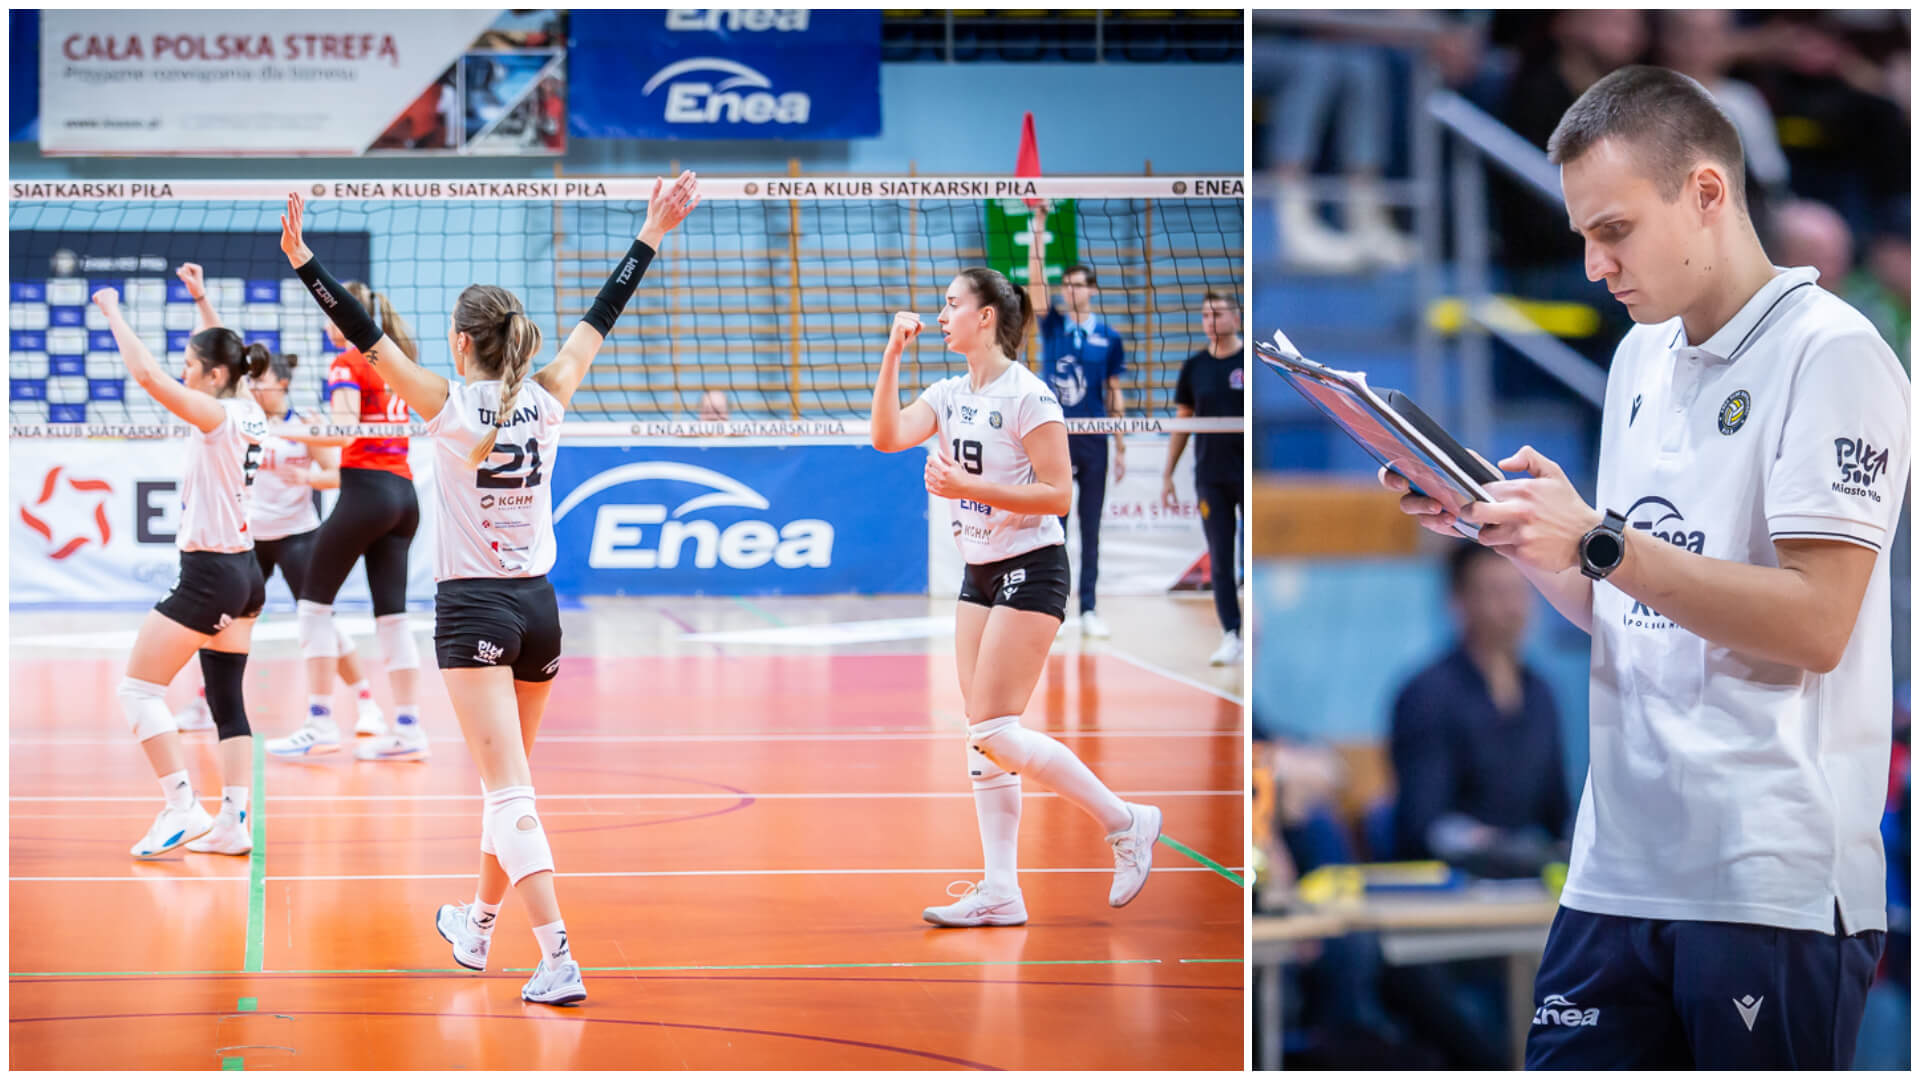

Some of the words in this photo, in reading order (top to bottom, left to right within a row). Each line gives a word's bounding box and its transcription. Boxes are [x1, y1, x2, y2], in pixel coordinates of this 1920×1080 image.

[665, 9, 811, 31] Enea
[62, 34, 145, 61] CAŁA
[153, 34, 275, 61] POLSKA
[284, 34, 399, 67] STREFĄ
[664, 83, 811, 124] Enea
[13, 183, 125, 198] SIATKARSKI
[131, 183, 174, 198] PIŁA
[334, 183, 385, 198] ENEA
[391, 183, 441, 198] KLUB
[447, 183, 559, 198] SIATKARSKI
[565, 183, 607, 198] PIŁA
[766, 182, 817, 197] ENEA
[824, 182, 873, 197] KLUB
[879, 182, 989, 197] SIATKARSKI
[995, 181, 1038, 196] PIŁA
[1194, 180, 1244, 196] ENEA
[616, 257, 639, 286] TEAM
[312, 278, 338, 309] TEAM
[9, 425, 42, 437] NEA
[47, 425, 83, 437] KLUB
[87, 425, 168, 437] SIATKARSKI
[326, 425, 363, 437] ENEA
[368, 425, 405, 437] KLUB
[647, 424, 684, 435] ENEA
[689, 424, 724, 435] KLUB
[729, 423, 809, 435] SIATKARSKI
[1131, 420, 1162, 432] PIŁA
[476, 437, 543, 488] 21
[952, 438, 983, 475] 19
[1831, 481, 1866, 497] Miasto
[498, 495, 534, 506] KGHM
[588, 503, 835, 569] Enea
[1632, 521, 1706, 555] ea
